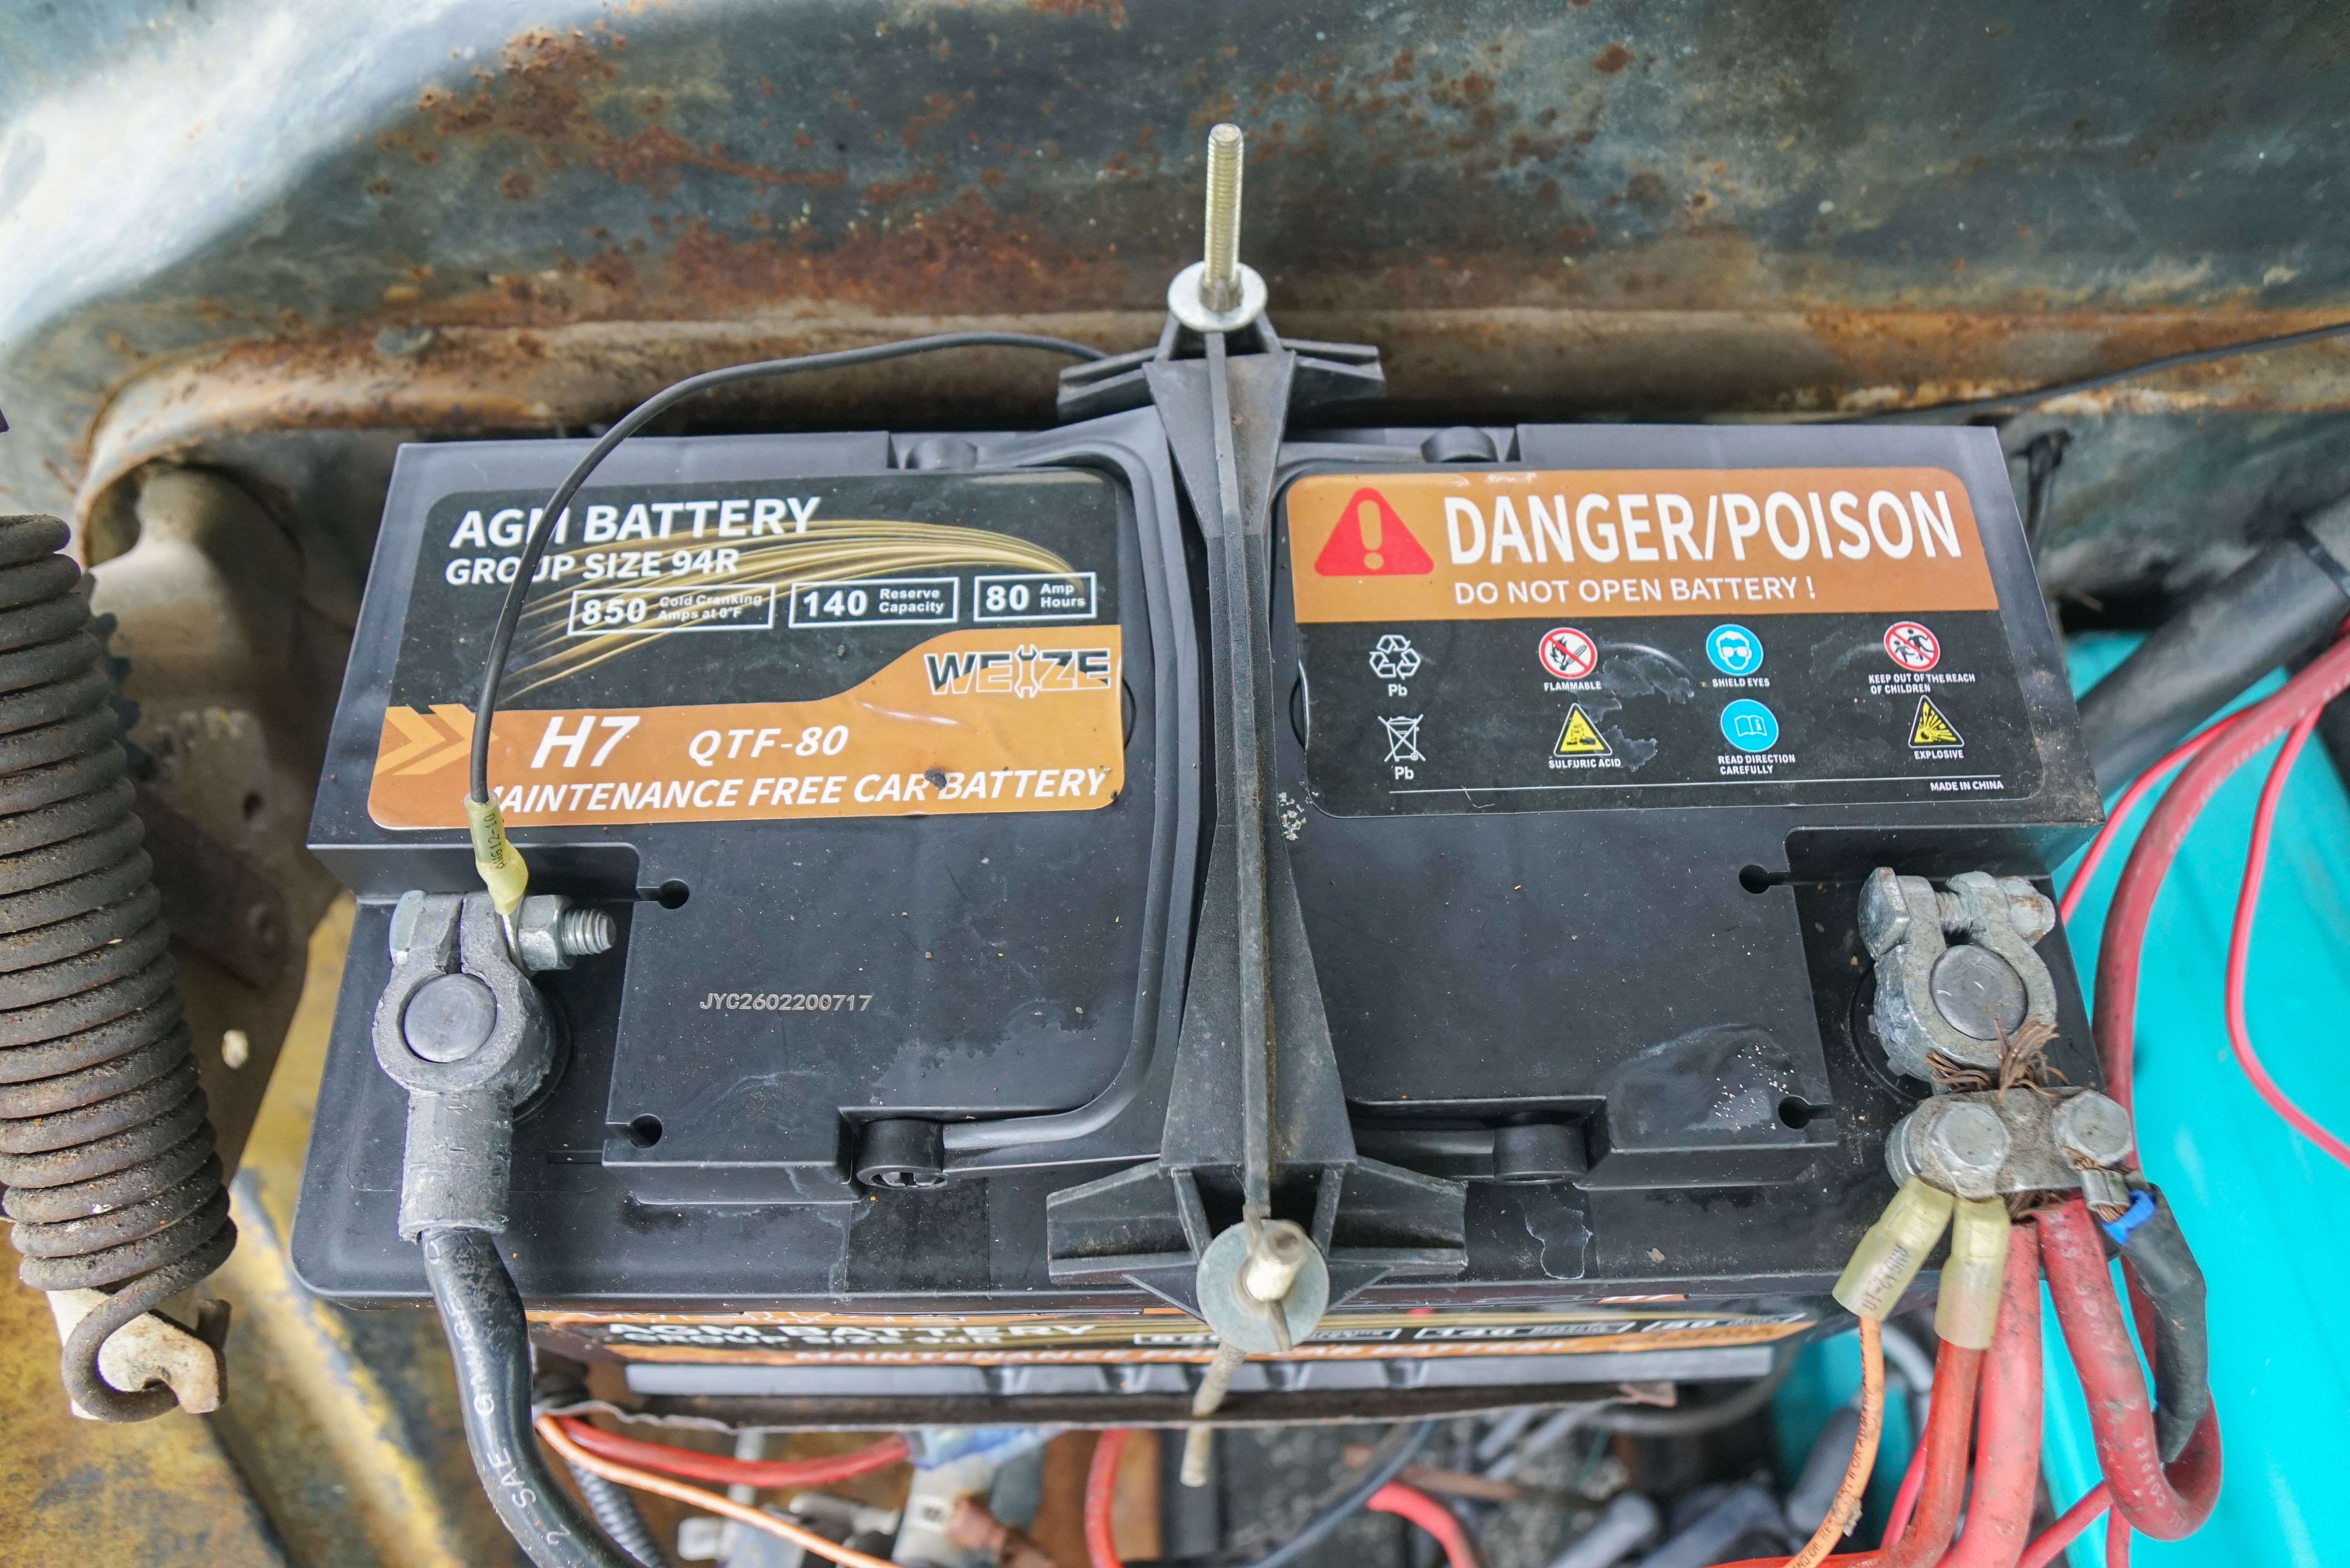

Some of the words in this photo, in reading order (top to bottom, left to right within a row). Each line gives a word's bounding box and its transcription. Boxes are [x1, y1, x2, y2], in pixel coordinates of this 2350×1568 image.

[583, 497, 821, 543] BATTERY
[1444, 489, 1962, 565] DANGER/POISON
[582, 551, 663, 580] SIZE
[671, 548, 740, 576] 94R
[879, 588, 939, 600] Reserve
[1040, 583, 1074, 596] Amp
[1455, 581, 1498, 606] DO
[1507, 580, 1570, 604] NOT
[1578, 578, 1662, 603] OPEN
[1670, 576, 1797, 601] BATTERY
[658, 594, 692, 608] Cold
[696, 593, 763, 606] Cranking
[803, 590, 867, 618] 140
[985, 584, 1029, 611] 80
[1040, 596, 1085, 608] Hours
[581, 598, 648, 625] 850
[657, 609, 700, 622] Amps
[702, 608, 715, 618] at
[879, 601, 944, 615] Capacity
[1712, 678, 1746, 688] SHIELD
[1747, 678, 1770, 687] EYES
[1868, 674, 1892, 684] KEEP
[1893, 673, 1912, 683] OUT
[1913, 673, 1925, 683] OF
[1926, 673, 1945, 683] THE
[1945, 673, 1976, 683] REACH
[1387, 683, 1407, 697] Pb
[1544, 681, 1602, 691] FLAMMABLE
[1870, 685, 1883, 694] OF
[1884, 683, 1931, 694] CHILDREN
[530, 715, 640, 769] H7
[688, 725, 849, 766] QTF-80
[1718, 755, 1745, 764] READ
[1746, 754, 1796, 764] DIRECTION
[1913, 749, 1964, 760] EXPLOSIVE
[1548, 759, 1597, 770] SULFURIC
[1598, 758, 1621, 768] ACID
[1720, 765, 1774, 775] CAREFULLY
[1395, 767, 1414, 779] Pb
[497, 778, 743, 813] AINTENANCE
[748, 775, 846, 807] FREE
[854, 774, 931, 803] CAR
[938, 768, 1111, 800] BATTERY
[1930, 781, 1958, 791] MADE
[1959, 781, 1971, 790] IN
[1972, 780, 2004, 790] CHINA
[700, 994, 872, 1011] JYC2602200717
[609, 1323, 762, 1336] AGM
[778, 1325, 1097, 1337] BATTERY
[487, 1447, 536, 1508] SAE
[2134, 1435, 2165, 1507] COPPER
